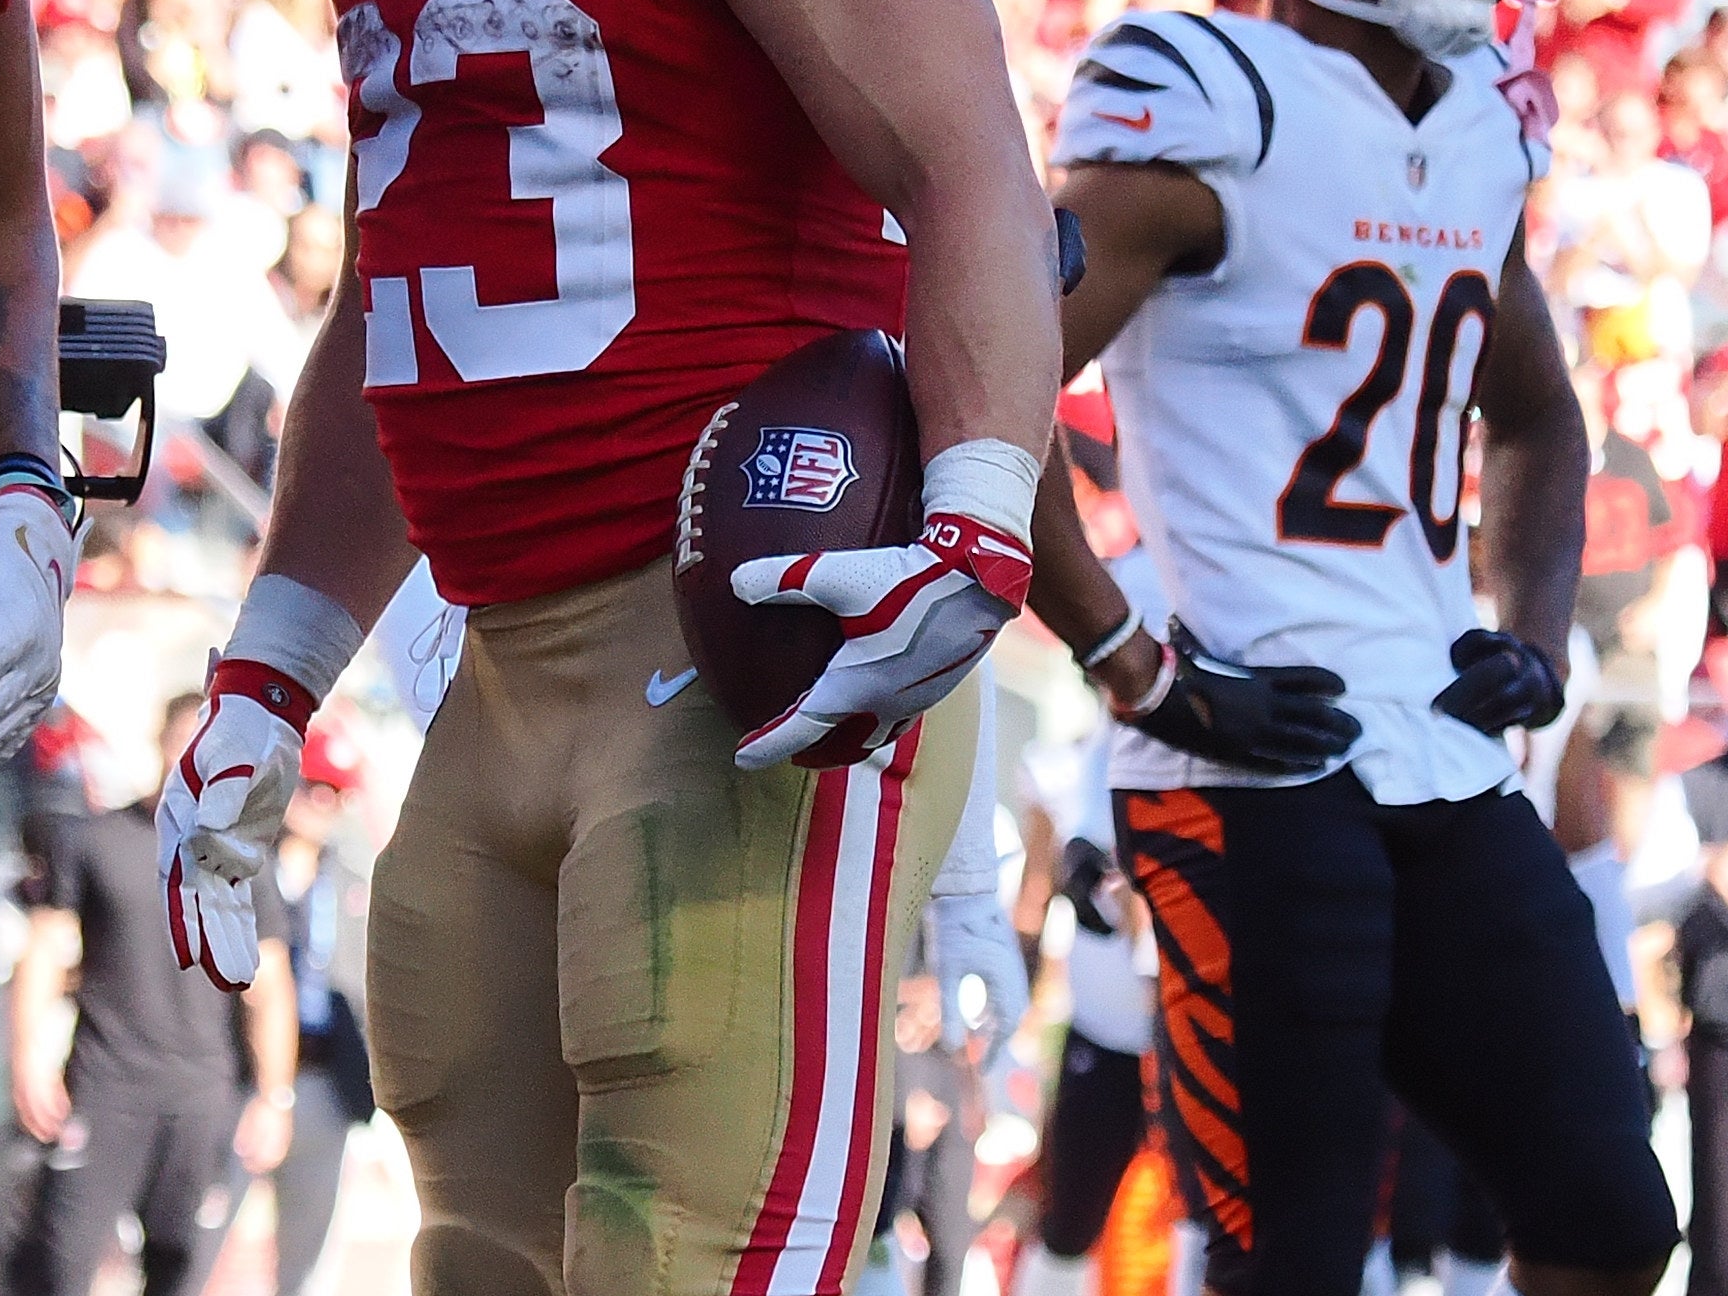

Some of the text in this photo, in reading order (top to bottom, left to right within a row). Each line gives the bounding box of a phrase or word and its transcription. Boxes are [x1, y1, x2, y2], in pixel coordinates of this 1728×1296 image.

[1353, 219, 1485, 251] BENGALS
[1275, 258, 1496, 564] 20
[785, 437, 842, 501] NFL
